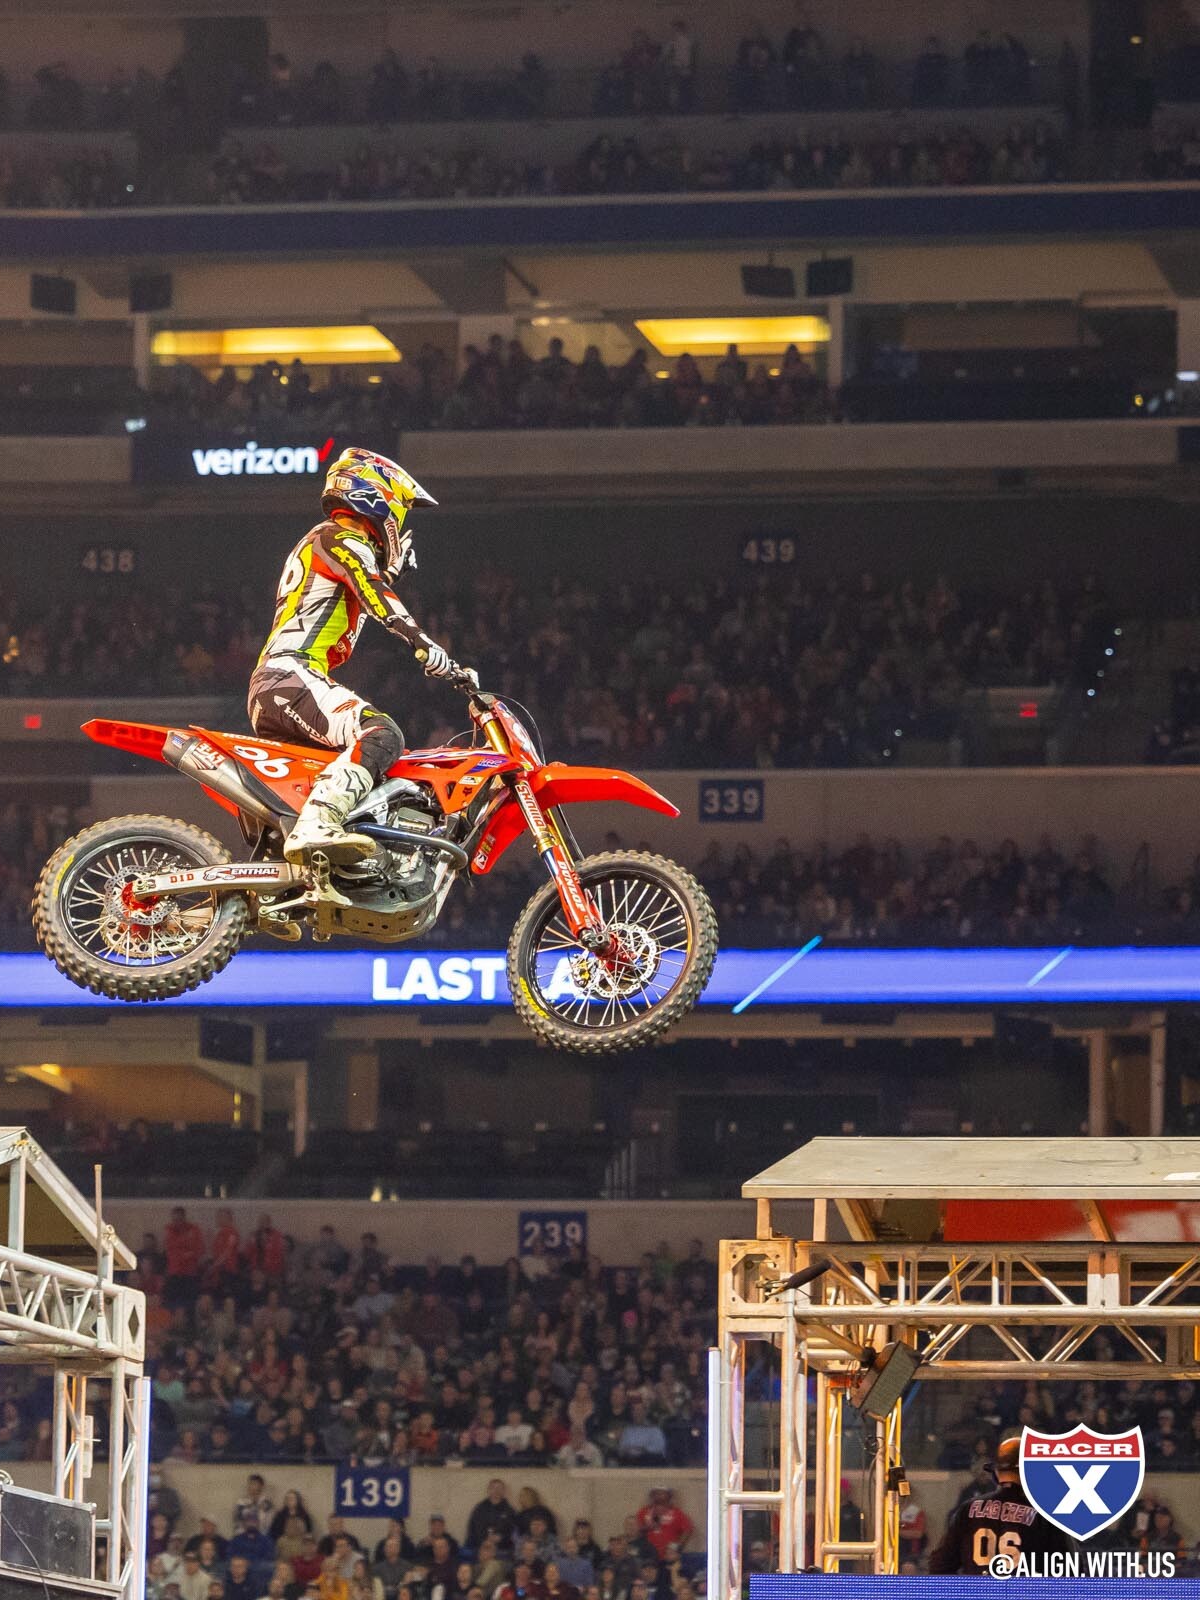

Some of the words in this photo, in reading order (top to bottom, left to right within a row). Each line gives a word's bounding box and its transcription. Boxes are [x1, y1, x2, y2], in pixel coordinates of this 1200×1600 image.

[192, 440, 319, 475] verizon
[82, 549, 134, 572] 438
[742, 539, 795, 563] 439
[284, 705, 335, 747] HONDA
[233, 744, 294, 778] 96
[703, 788, 759, 813] 339
[170, 873, 194, 884] DID
[373, 957, 506, 1001] LAST
[524, 1221, 582, 1249] 239
[341, 1478, 403, 1507] 139
[968, 1500, 999, 1520] FLAG
